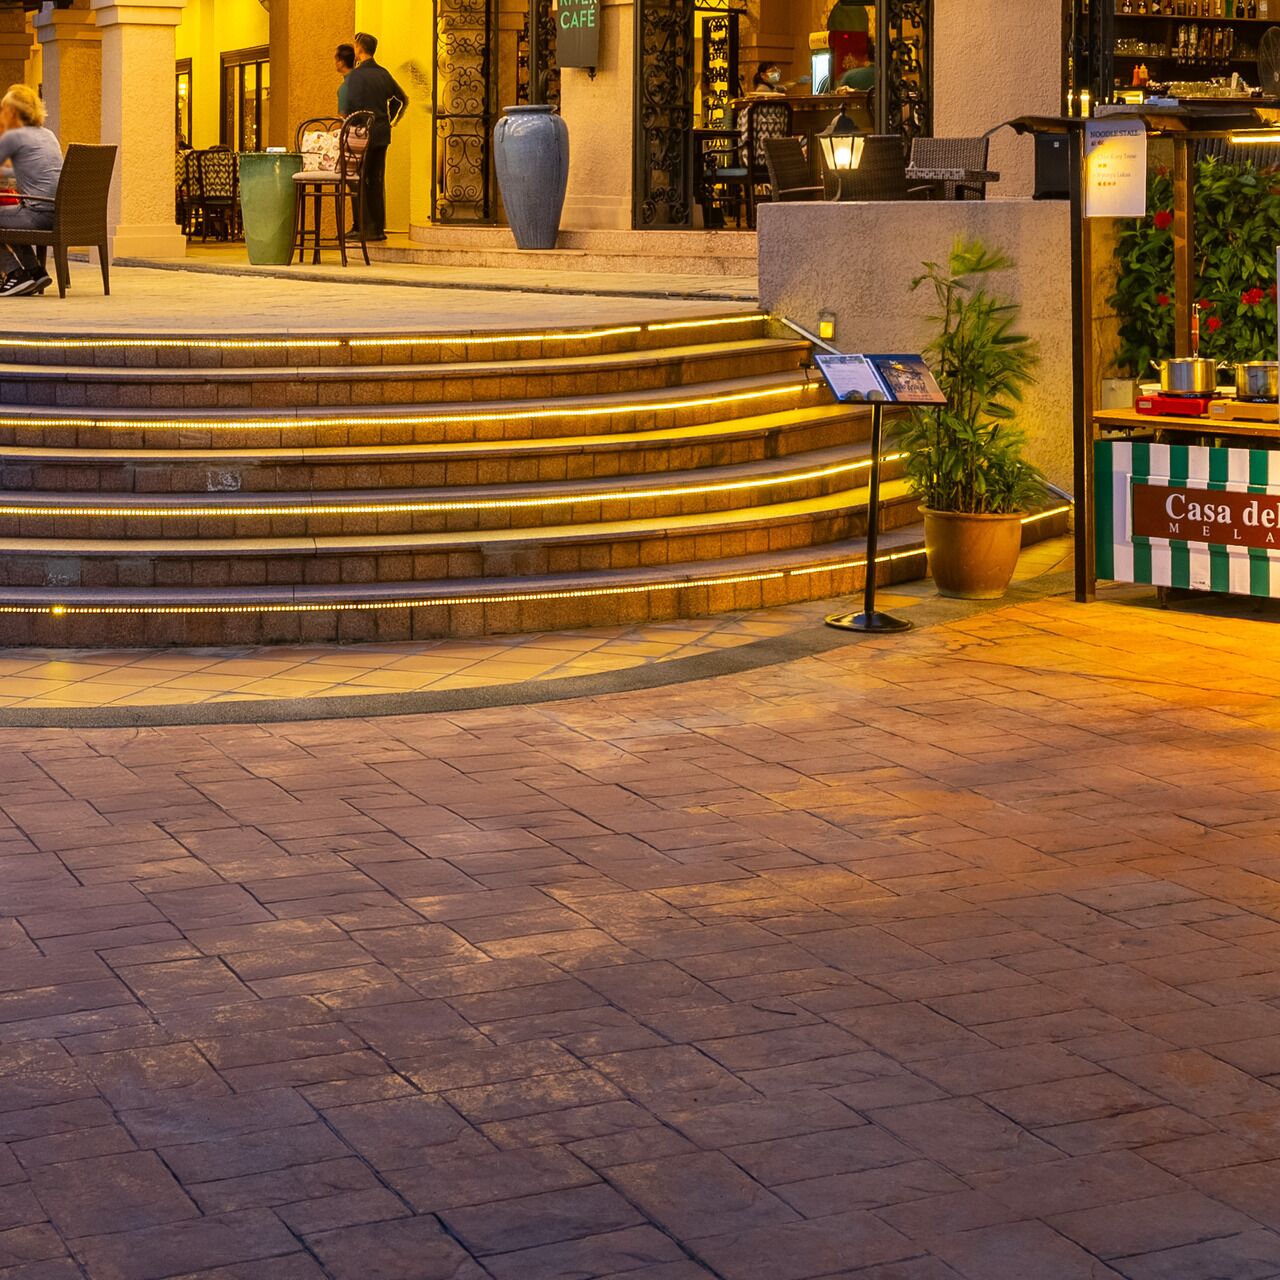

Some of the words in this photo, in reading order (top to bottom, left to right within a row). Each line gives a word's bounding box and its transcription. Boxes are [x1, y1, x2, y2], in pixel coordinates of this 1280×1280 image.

[560, 5, 596, 29] CAFÉ
[1090, 130, 1118, 138] NOODLE
[1118, 129, 1141, 137] STALL
[1165, 493, 1232, 524] Casa
